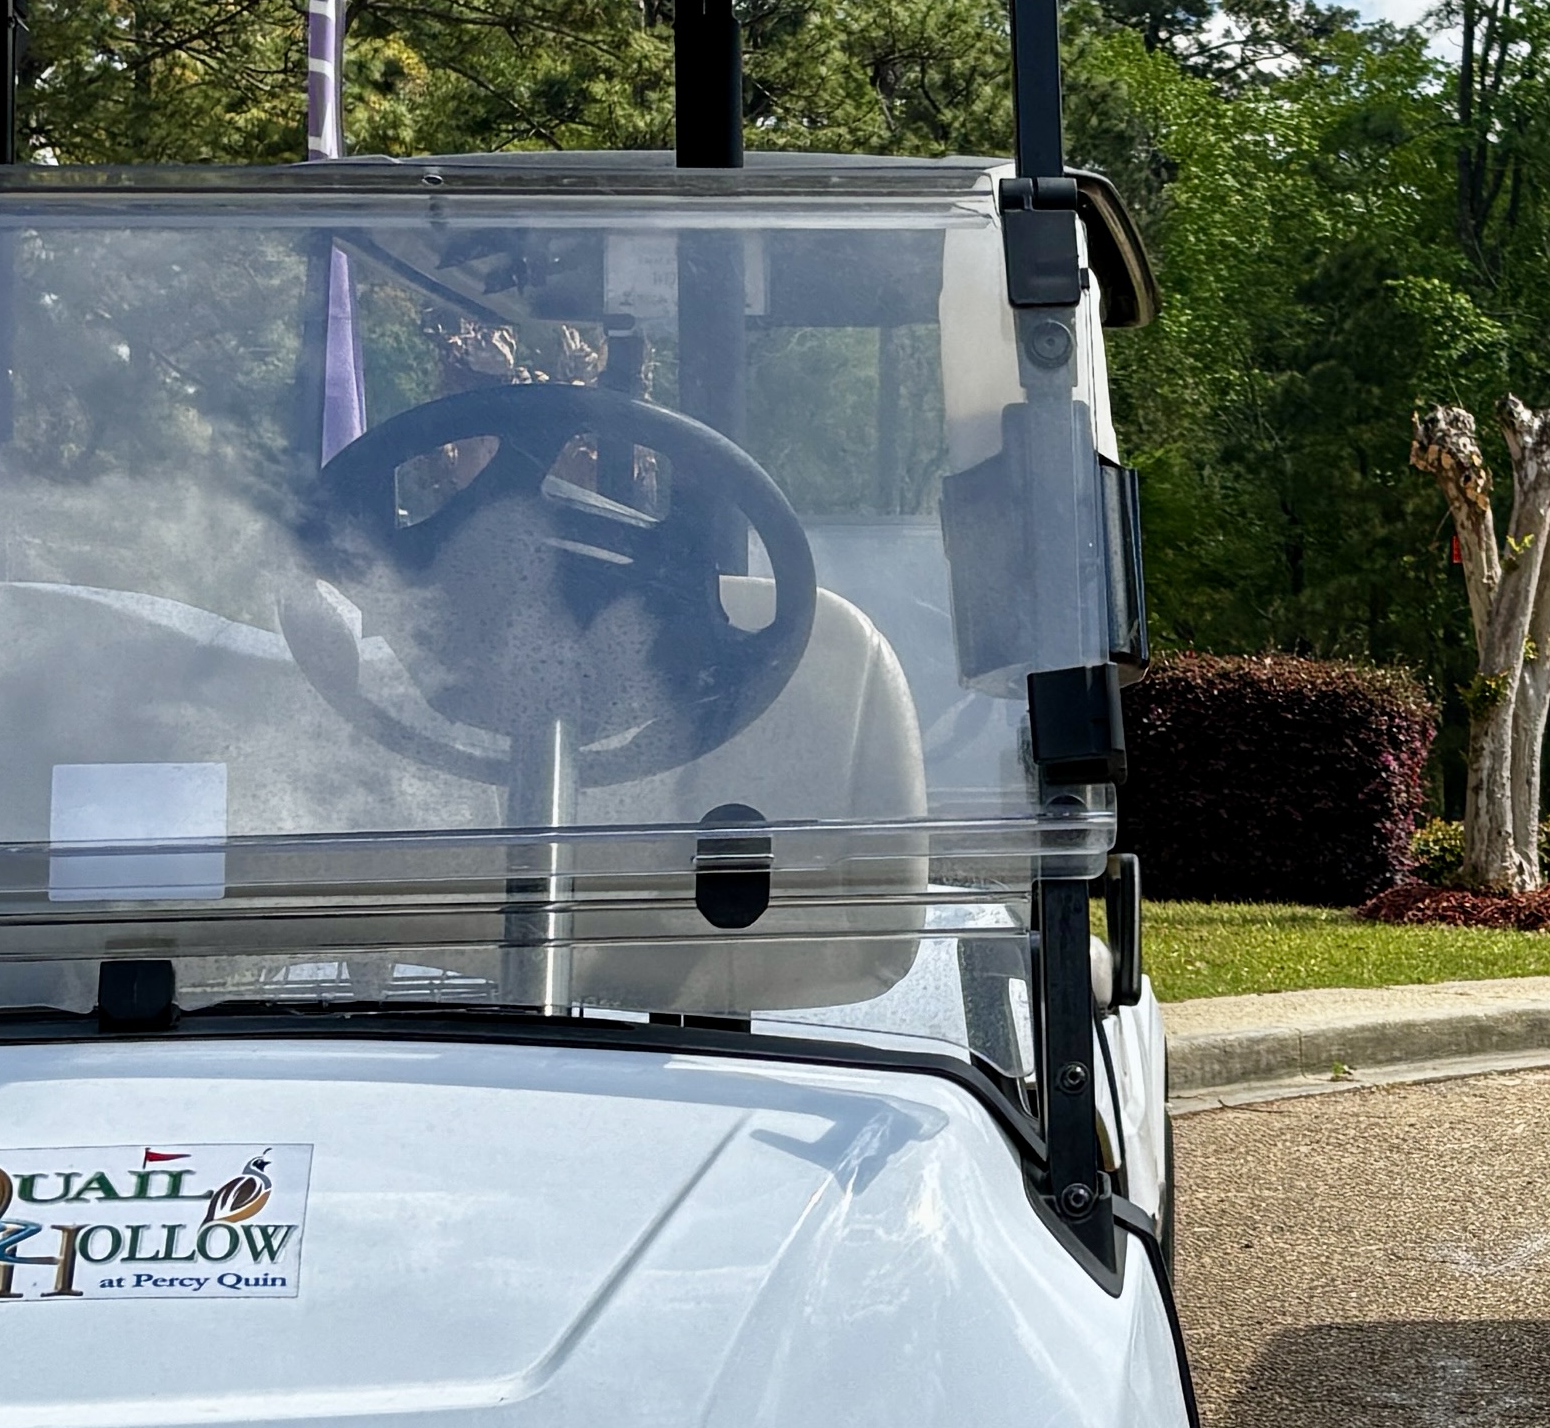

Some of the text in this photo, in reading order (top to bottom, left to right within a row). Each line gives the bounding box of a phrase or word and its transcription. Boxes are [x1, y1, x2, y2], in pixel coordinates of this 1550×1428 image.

[99, 1273, 287, 1292] at Percy Quin
